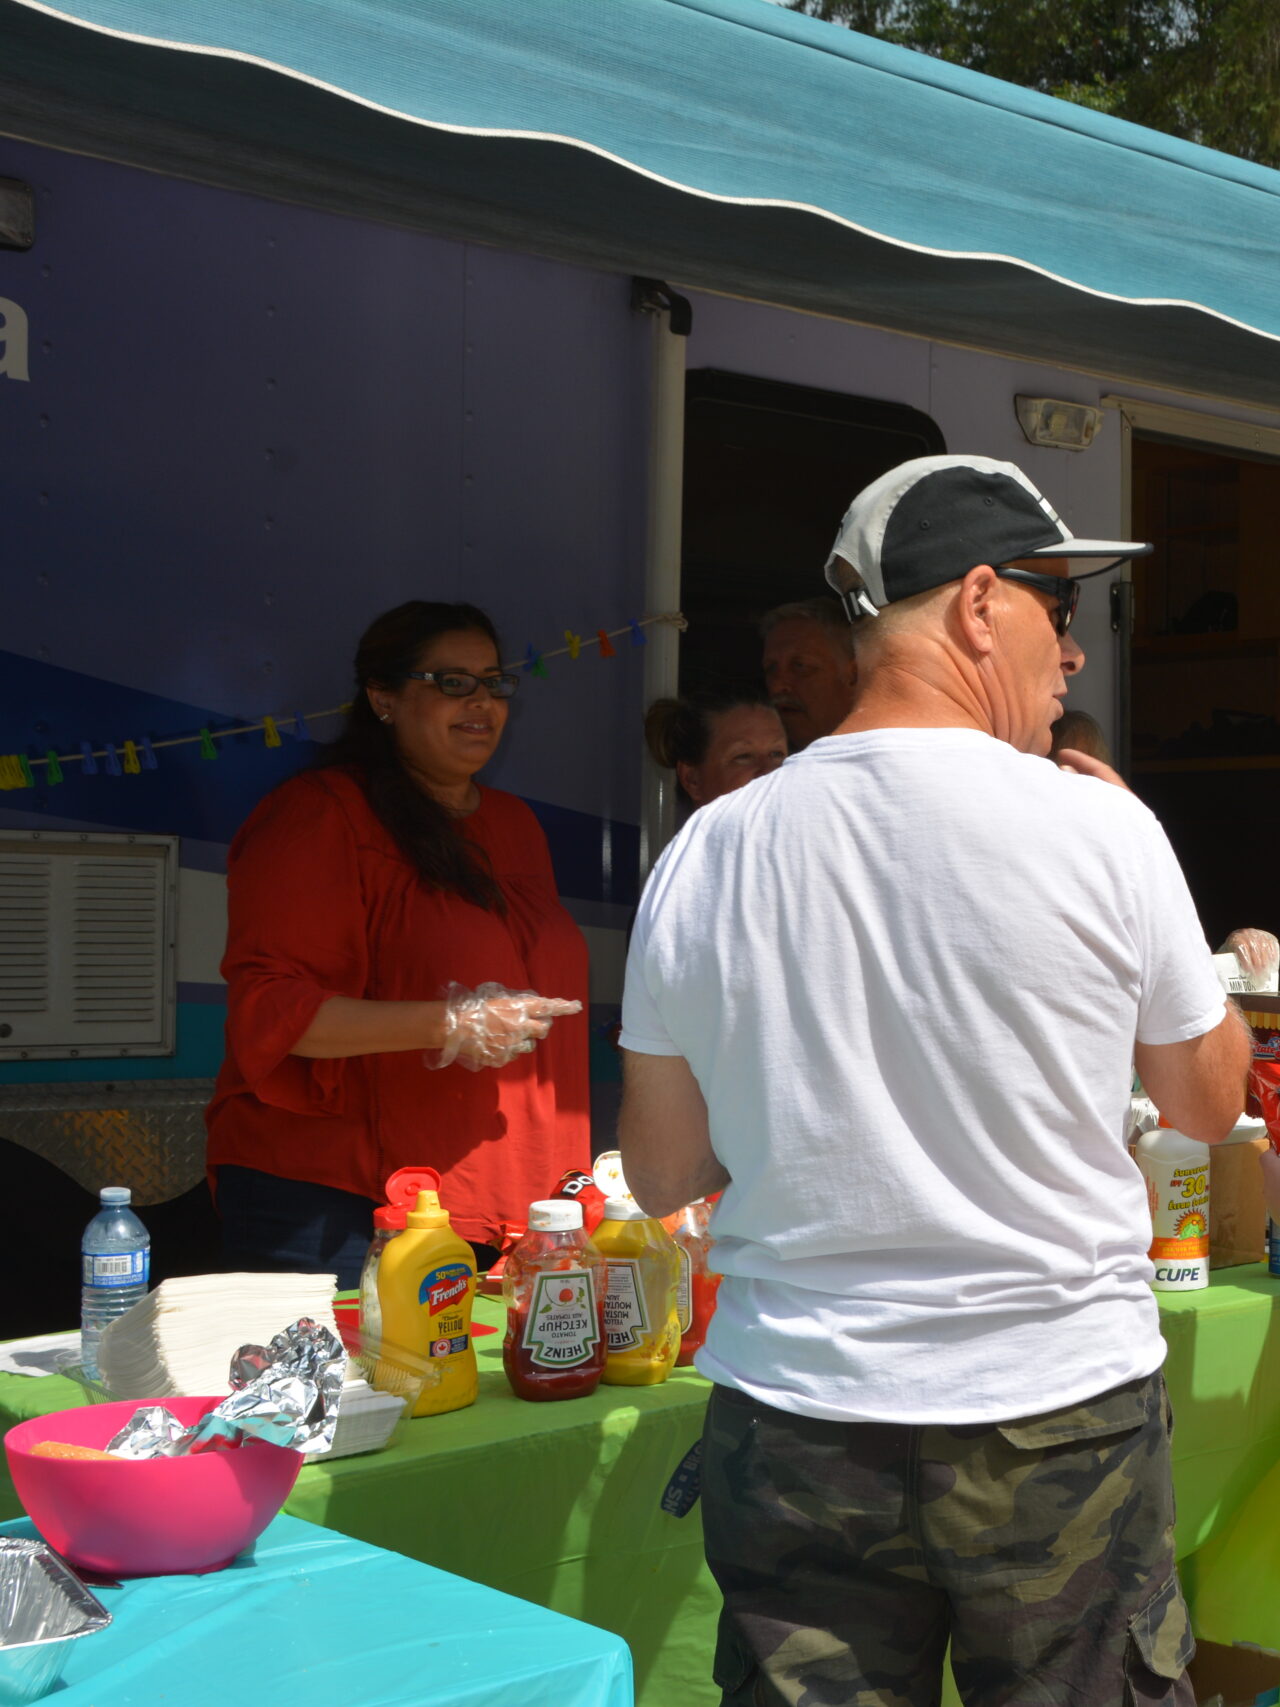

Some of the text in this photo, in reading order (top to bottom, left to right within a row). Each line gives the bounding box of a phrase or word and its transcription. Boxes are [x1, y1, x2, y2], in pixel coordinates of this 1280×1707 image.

[1181, 1174, 1206, 1198] 30
[1155, 1267, 1200, 1282] CUPE
[432, 1279, 467, 1306] French's
[438, 1317, 463, 1335] YELLOW
[538, 1319, 588, 1332] KETCHUP
[551, 1331, 577, 1339] TOMATO
[607, 1331, 631, 1344] HEI
[544, 1343, 583, 1358] HEINZ
